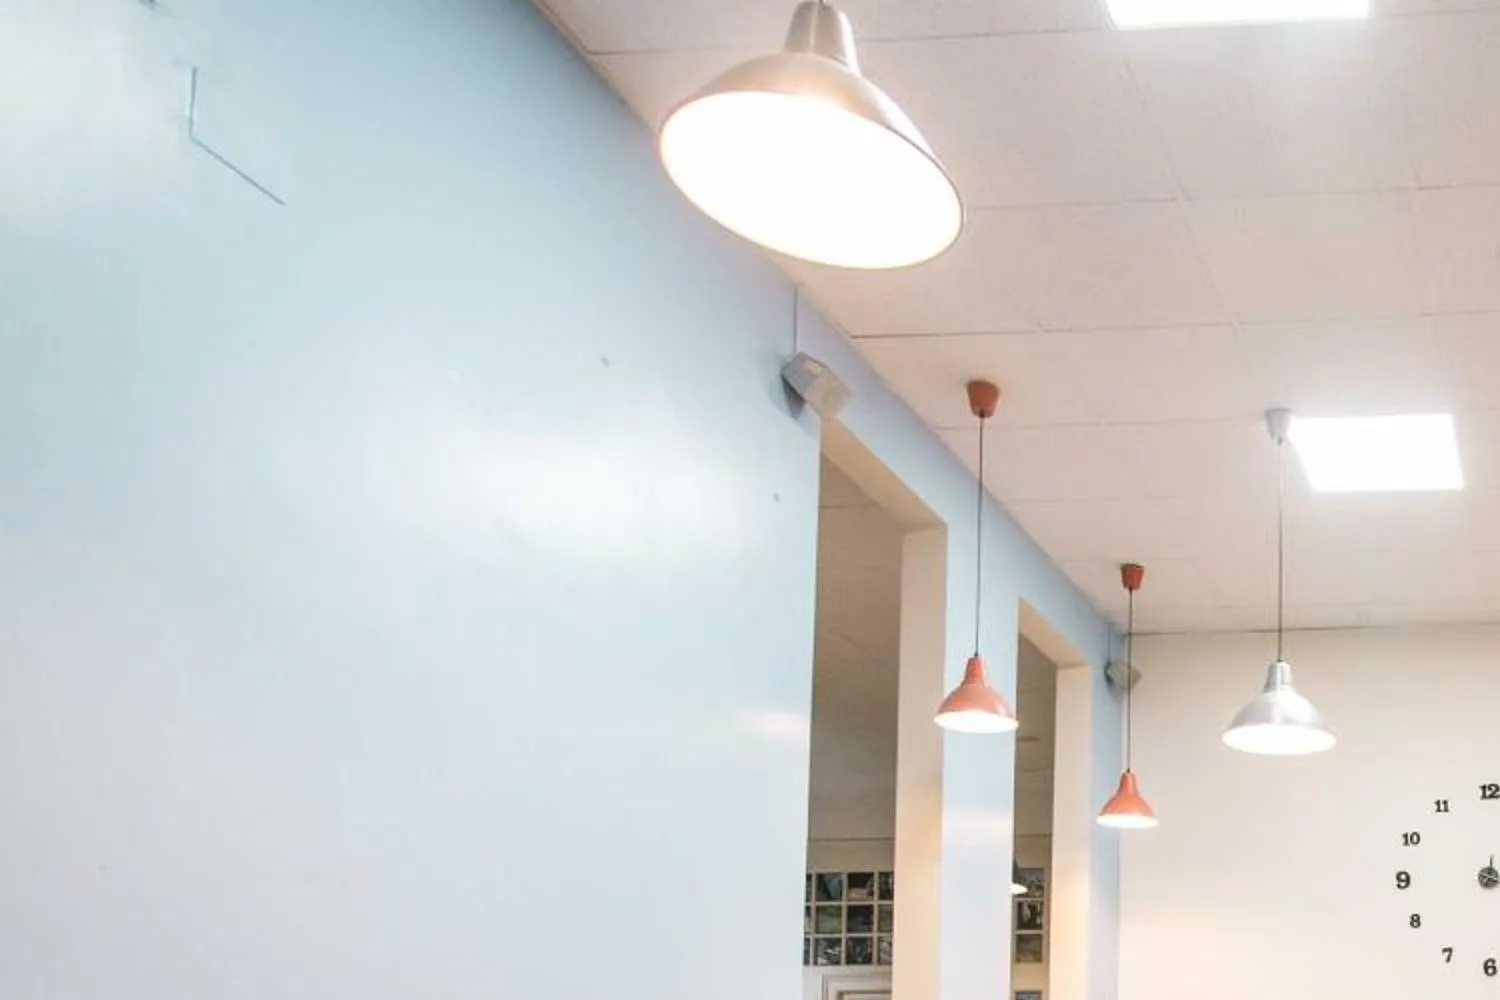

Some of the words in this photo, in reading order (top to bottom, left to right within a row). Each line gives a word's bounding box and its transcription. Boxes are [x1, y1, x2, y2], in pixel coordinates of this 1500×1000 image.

[1479, 783, 1500, 800] 12
[1434, 799, 1450, 813] 11
[1402, 832, 1421, 846] 10
[1395, 870, 1411, 890] 9
[1409, 913, 1421, 929] 8
[1441, 947, 1453, 963] 7
[1483, 958, 1498, 977] 6
